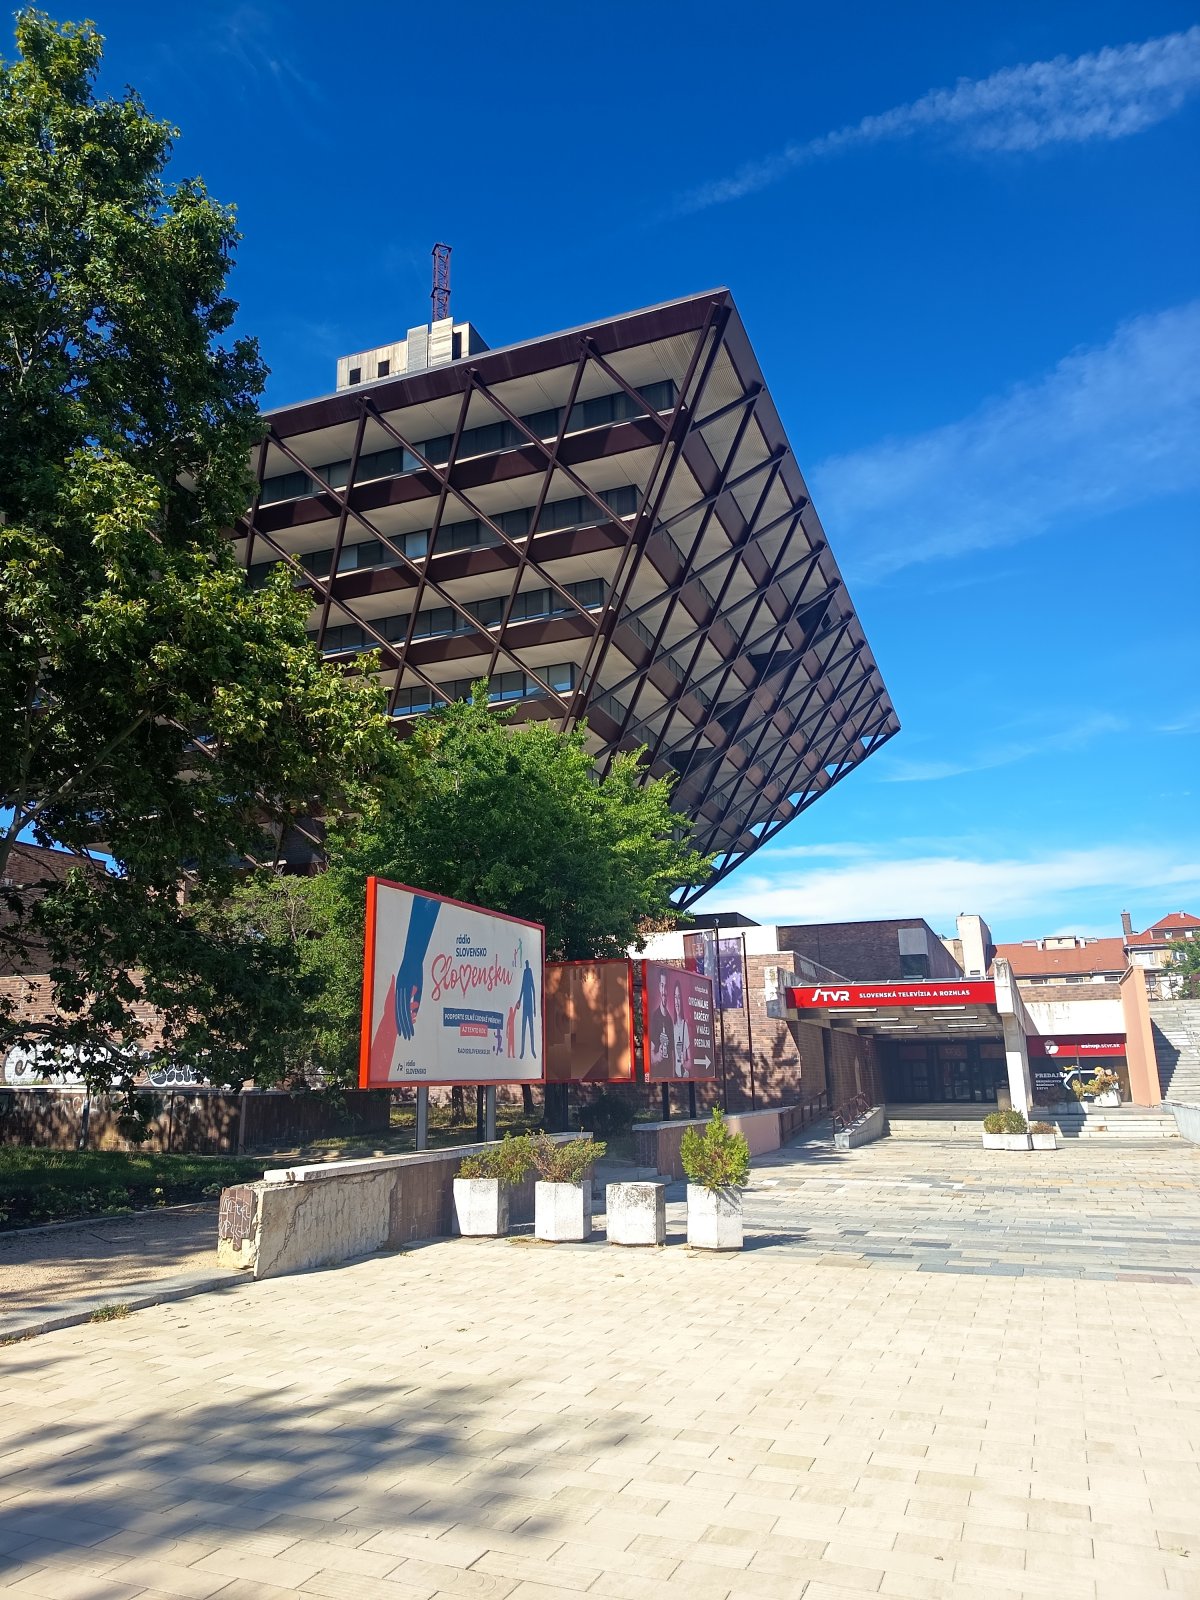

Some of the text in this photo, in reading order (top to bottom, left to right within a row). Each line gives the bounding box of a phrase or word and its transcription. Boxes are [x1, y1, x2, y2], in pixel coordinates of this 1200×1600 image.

[455, 947, 487, 957] SLOVENSKO
[859, 990, 897, 998] SLOVENSKÁ
[939, 989, 970, 997] ROZHLAS
[688, 996, 709, 1010] ORIGINÁLNE
